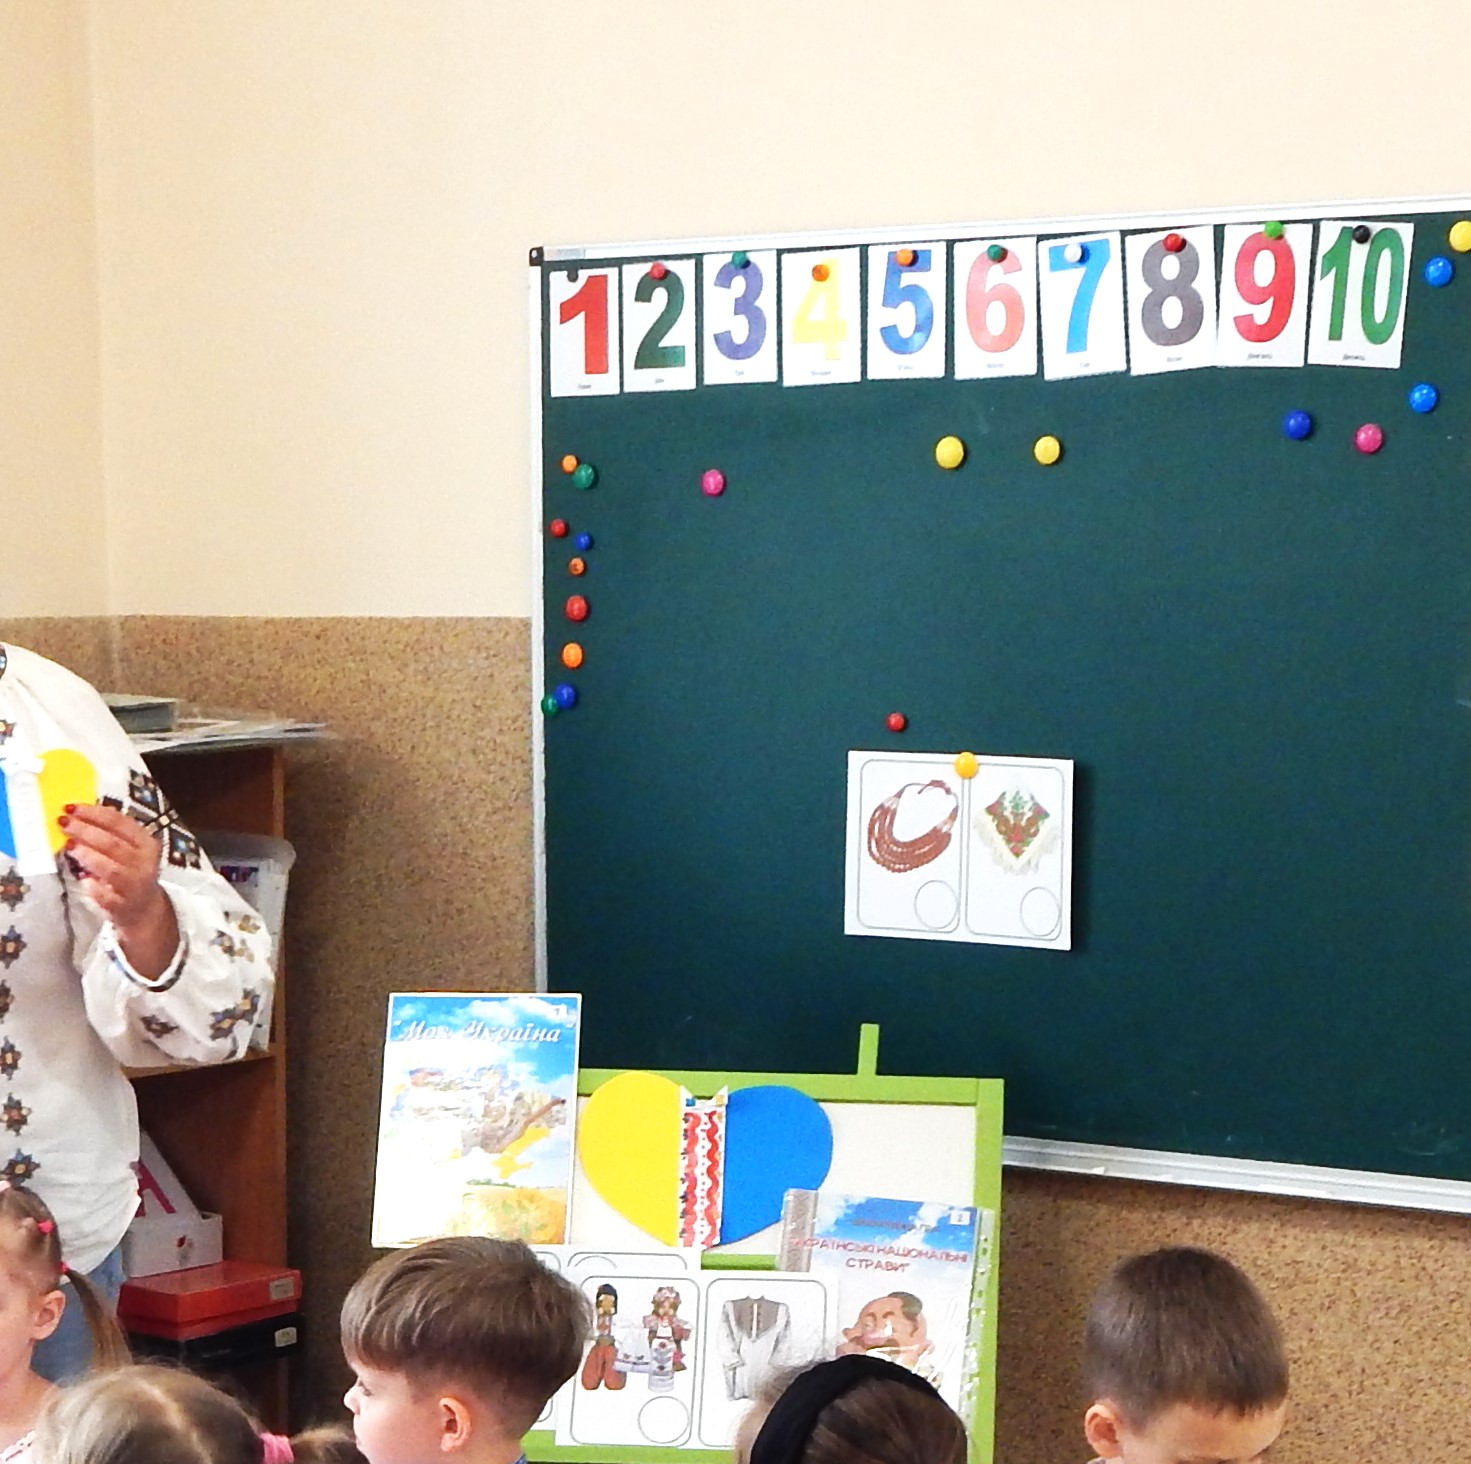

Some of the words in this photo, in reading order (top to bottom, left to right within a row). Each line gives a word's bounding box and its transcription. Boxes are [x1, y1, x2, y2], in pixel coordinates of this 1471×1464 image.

[559, 274, 609, 374] 1
[633, 270, 687, 370] 2
[713, 259, 767, 360] 3
[792, 258, 849, 361] 4
[879, 249, 934, 354] 5
[965, 248, 1025, 353] 6
[1048, 239, 1111, 354] 7
[1141, 238, 1205, 346] 8
[1233, 230, 1296, 343] 9
[1319, 226, 1405, 345] 10
